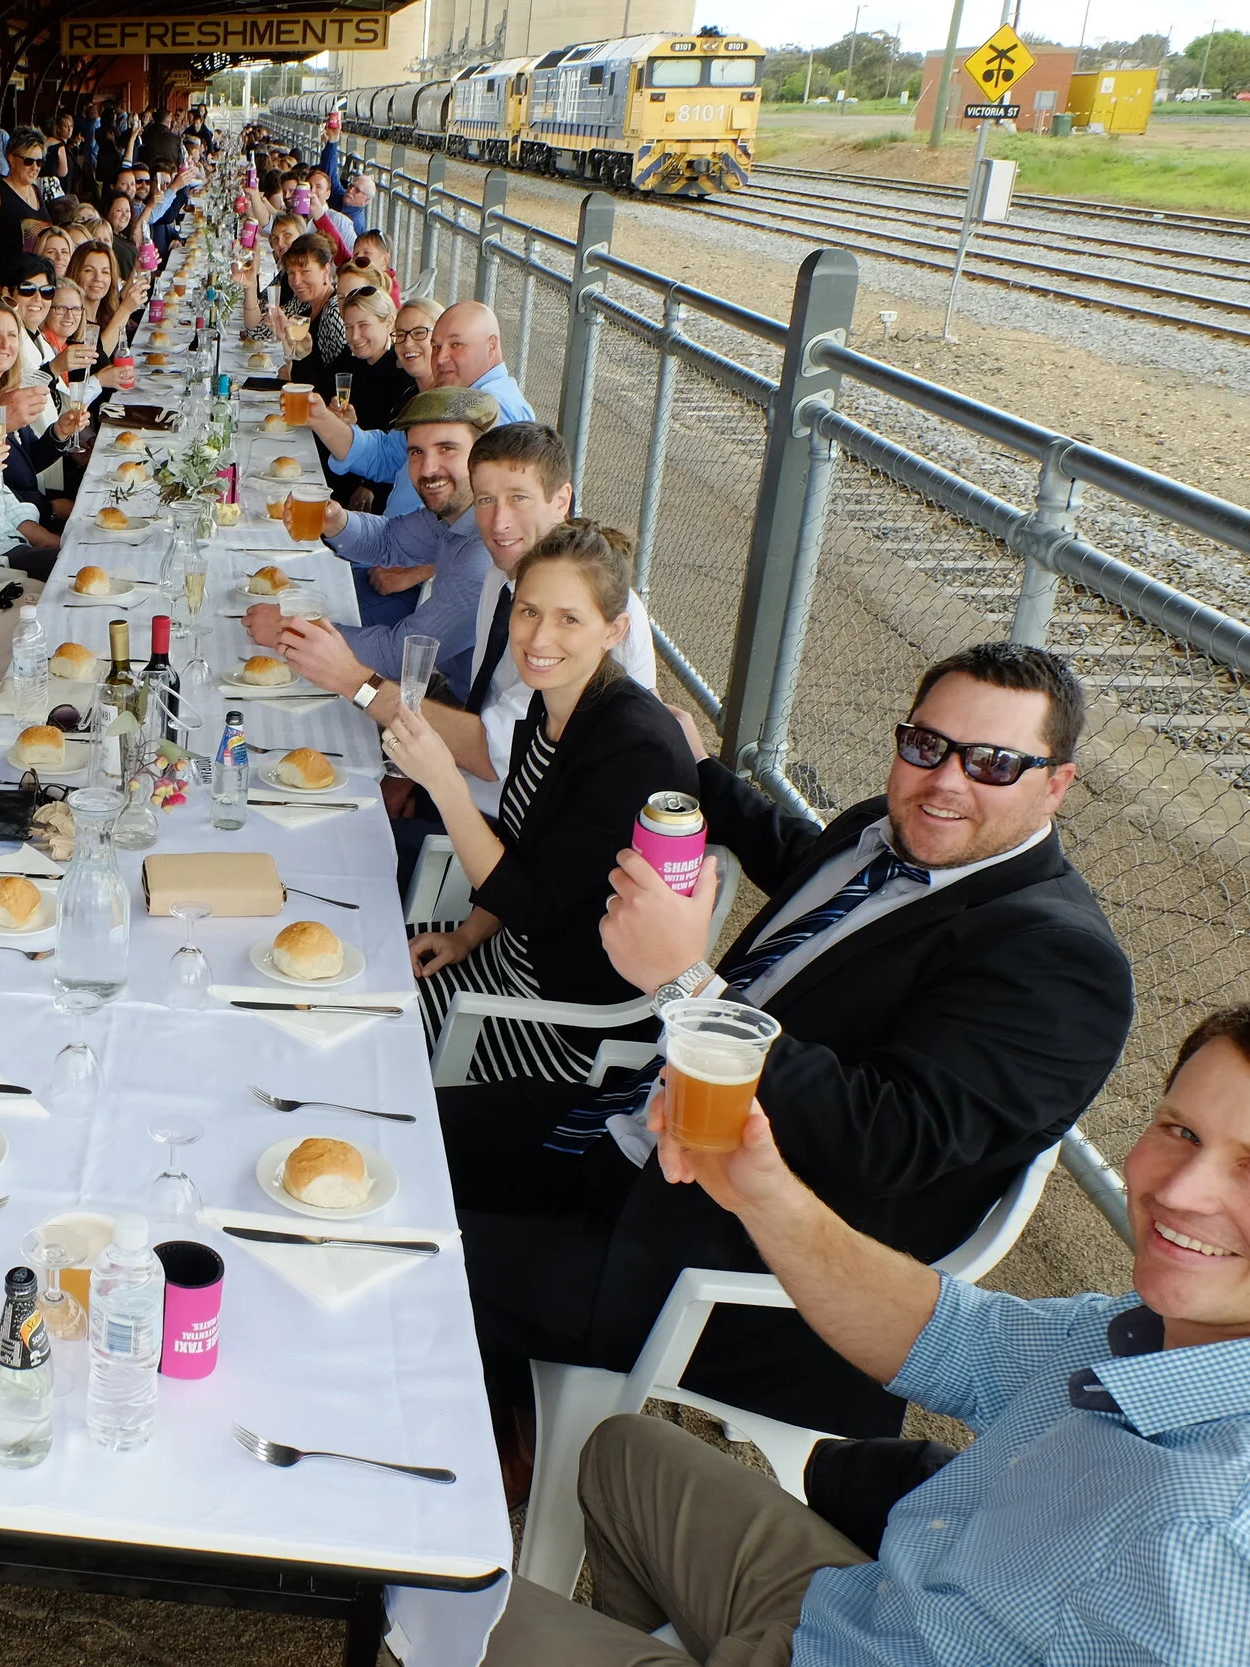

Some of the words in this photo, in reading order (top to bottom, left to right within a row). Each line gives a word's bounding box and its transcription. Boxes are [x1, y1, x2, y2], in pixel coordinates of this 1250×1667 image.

[68, 18, 380, 49] REFRESHMENTS
[677, 104, 725, 122] 8101
[967, 106, 1005, 117] VICTORIA
[1006, 107, 1019, 117] ST
[663, 857, 700, 873] SHARE
[664, 874, 686, 882] WITH
[671, 882, 688, 891] NEW
[174, 1340, 204, 1353] TAXI
